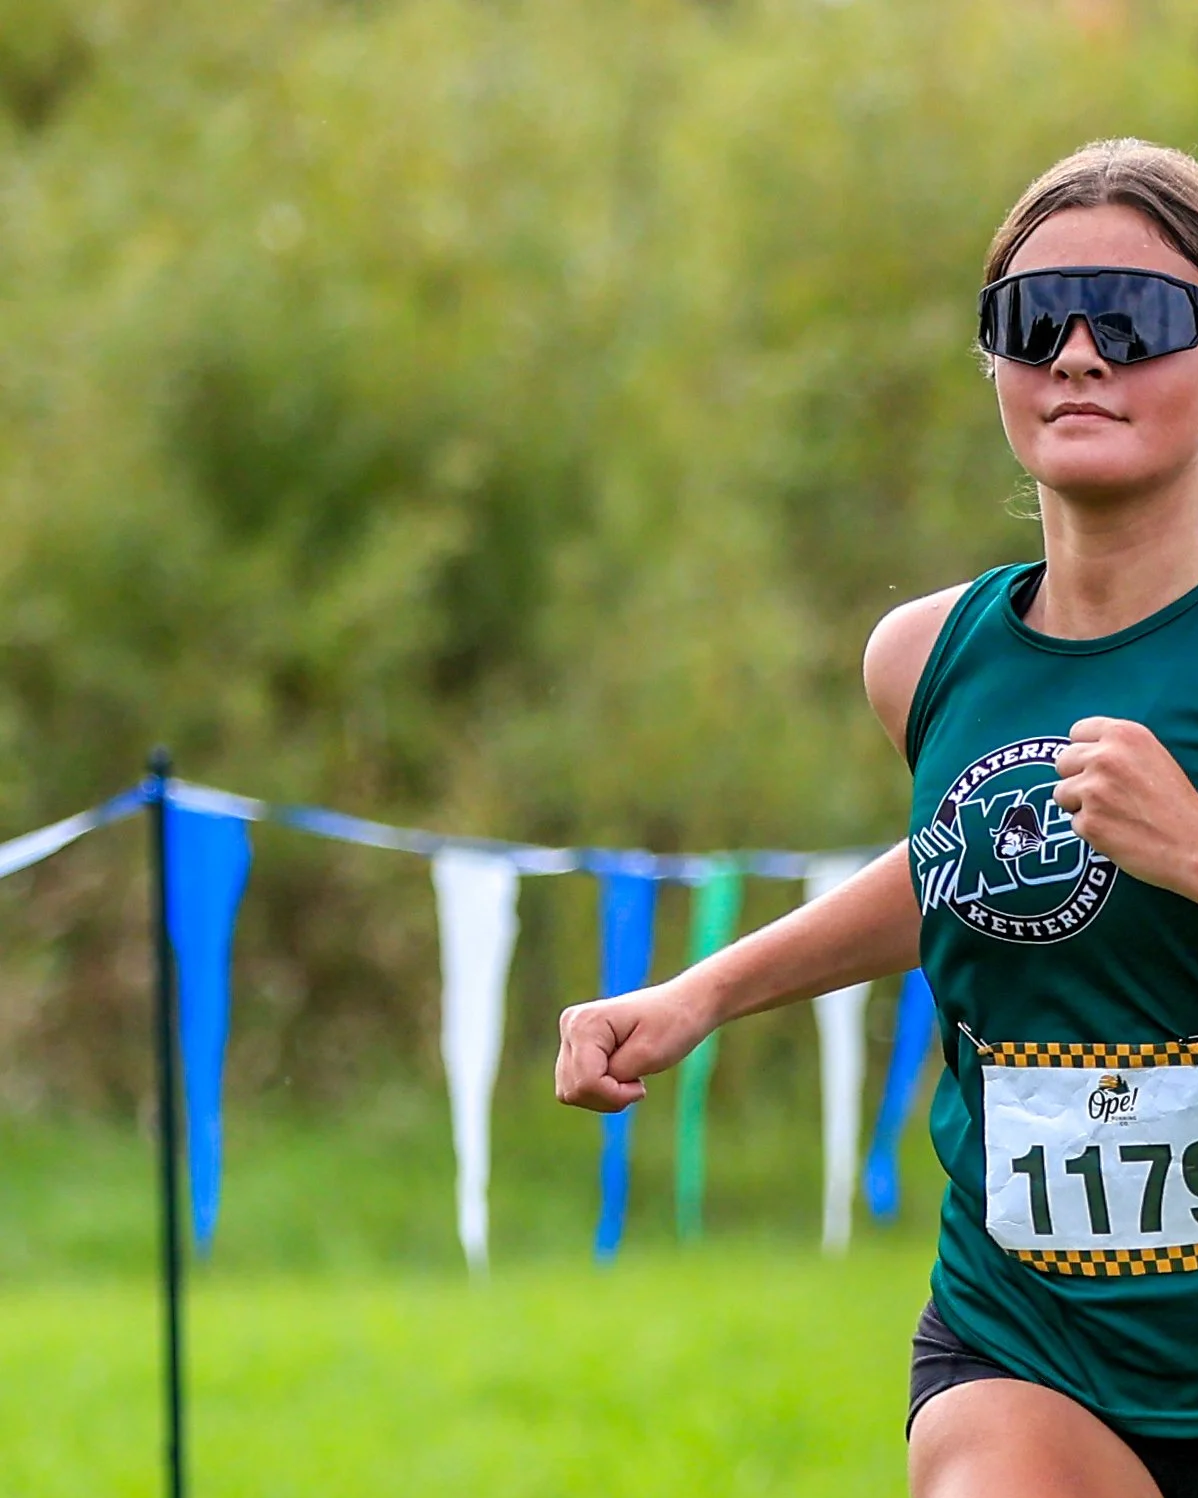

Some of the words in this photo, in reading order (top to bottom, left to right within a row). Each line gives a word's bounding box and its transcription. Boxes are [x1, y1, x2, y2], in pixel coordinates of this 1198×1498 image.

[949, 743, 1069, 803] WATERFO
[967, 866, 1108, 936] KETTERING
[1088, 1087, 1138, 1123] Ope!
